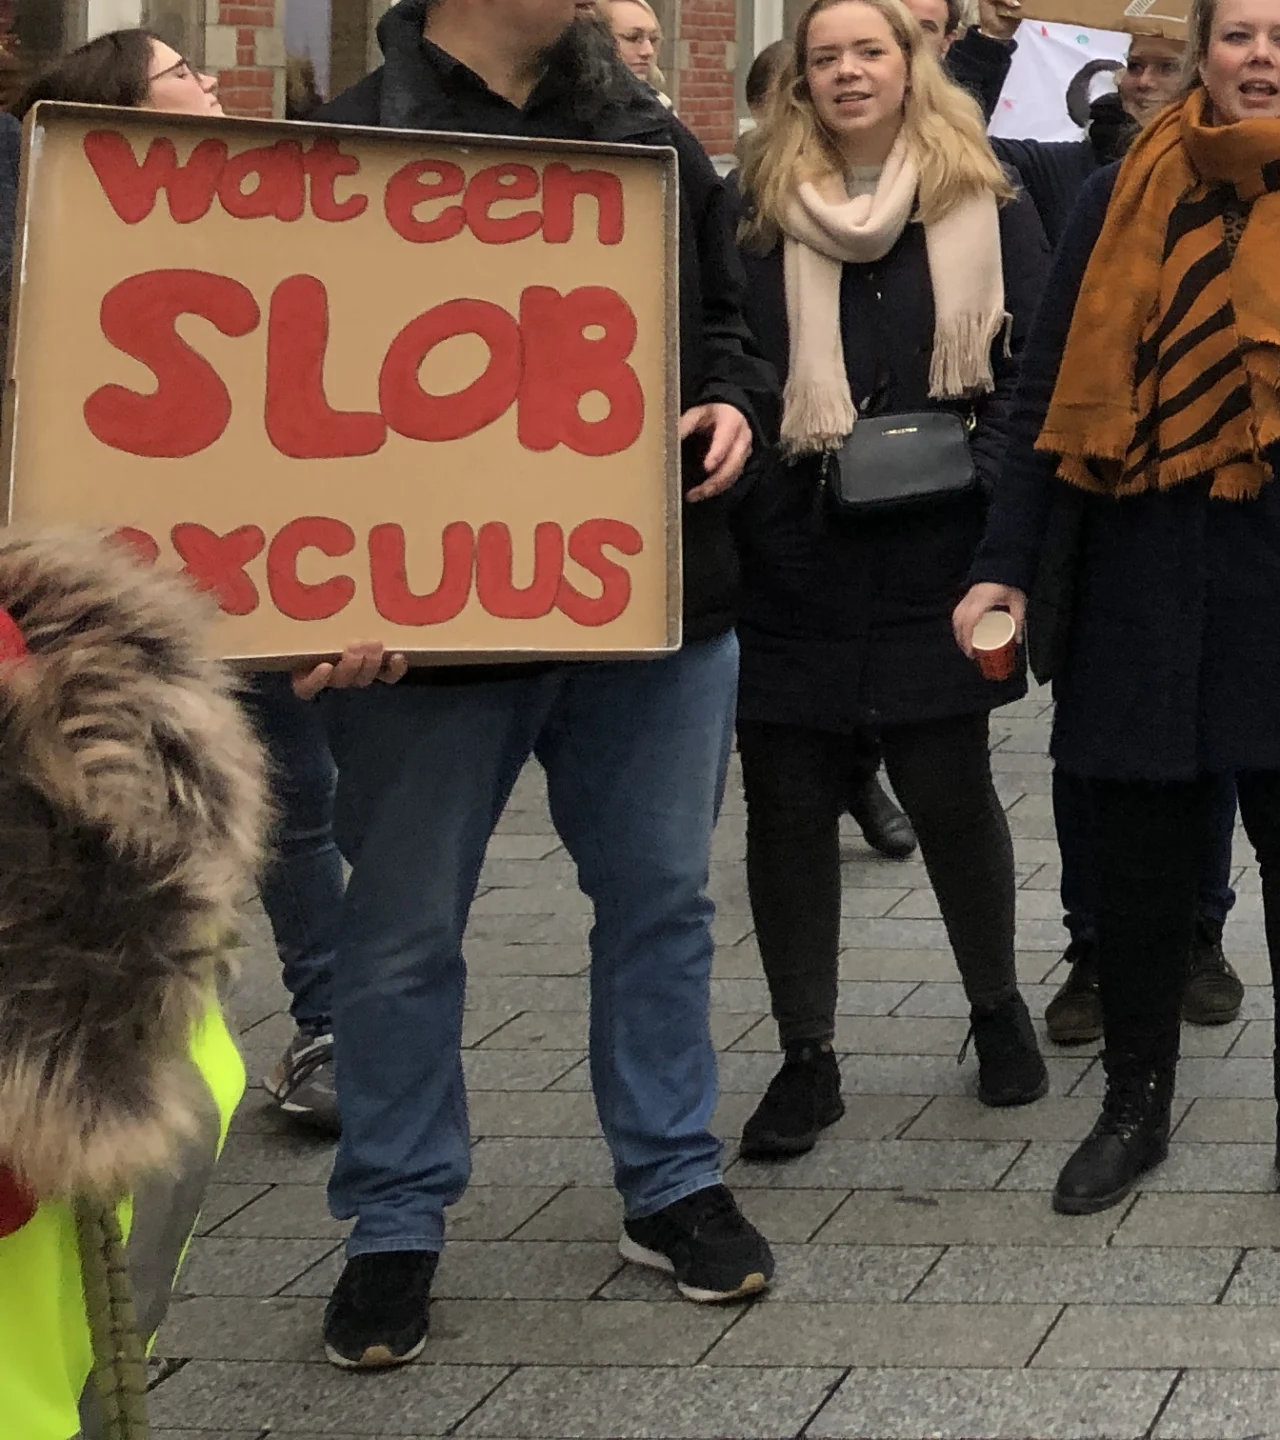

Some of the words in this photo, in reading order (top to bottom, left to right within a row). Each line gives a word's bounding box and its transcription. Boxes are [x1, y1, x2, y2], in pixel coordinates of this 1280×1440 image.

[384, 160, 624, 245] een
[83, 268, 644, 459] SLOB
[112, 515, 643, 627] xcuus
